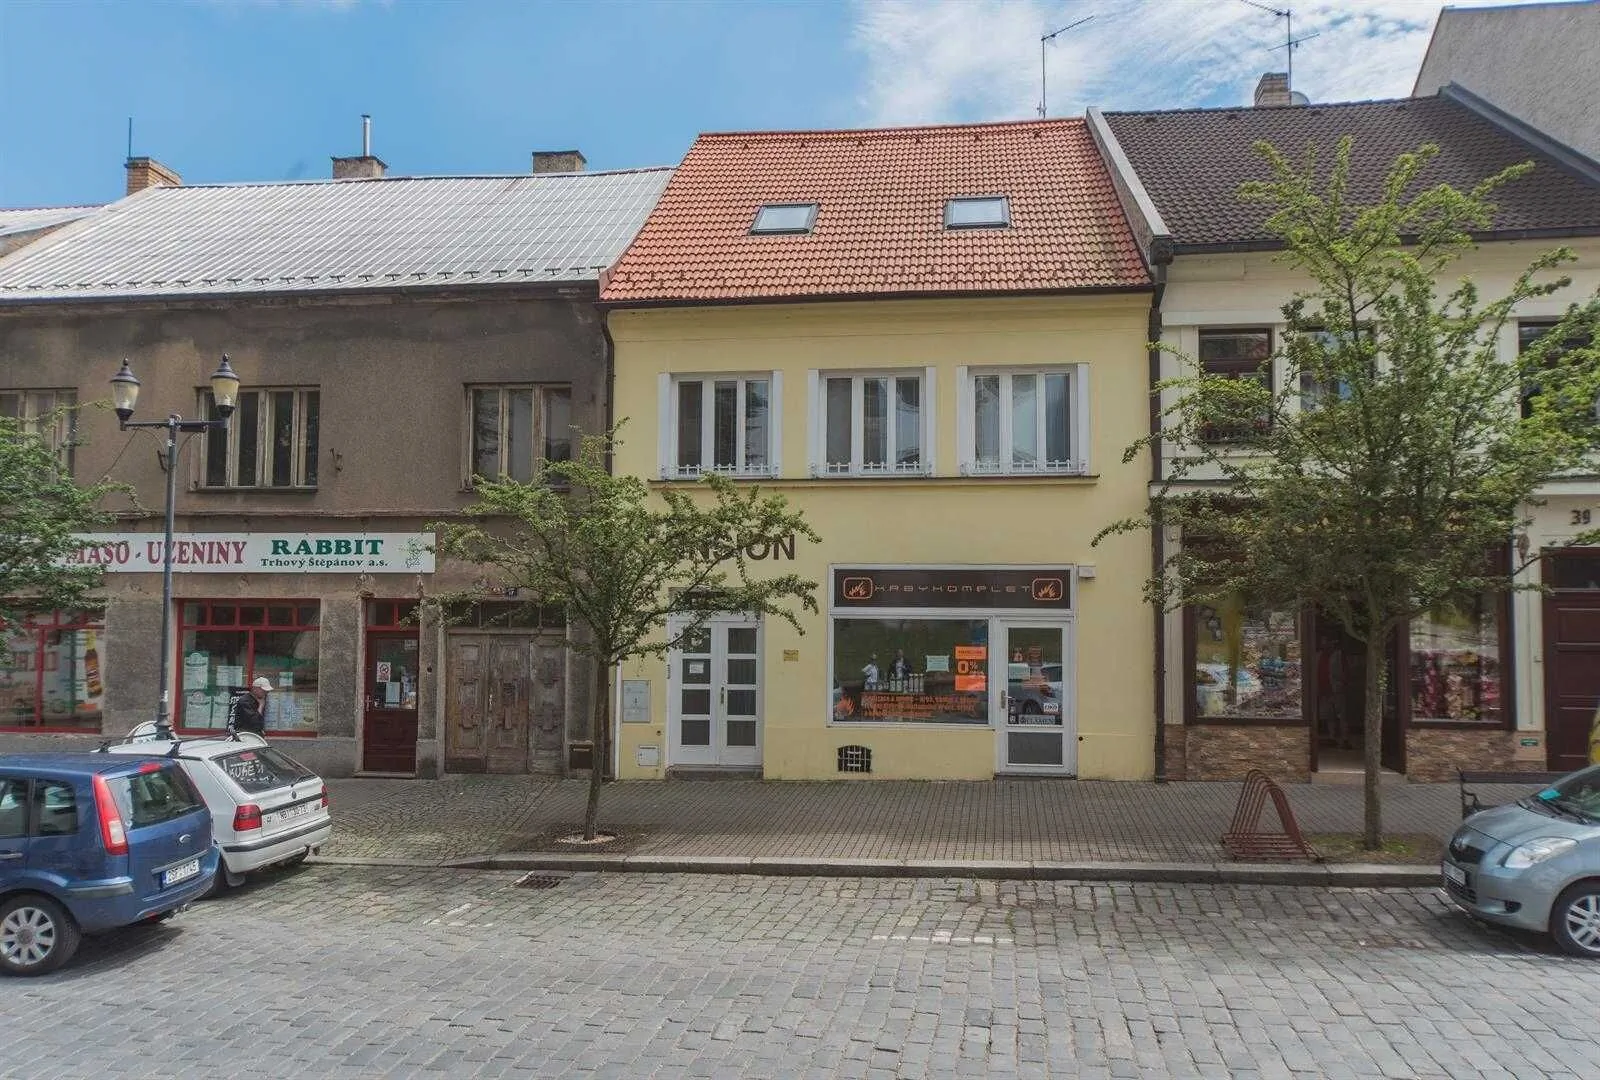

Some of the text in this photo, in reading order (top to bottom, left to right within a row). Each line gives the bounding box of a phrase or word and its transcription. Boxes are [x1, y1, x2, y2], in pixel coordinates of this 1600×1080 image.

[271, 539, 384, 555] RABBIT
[261, 558, 306, 568] Trhový
[368, 559, 388, 567] a.s.
